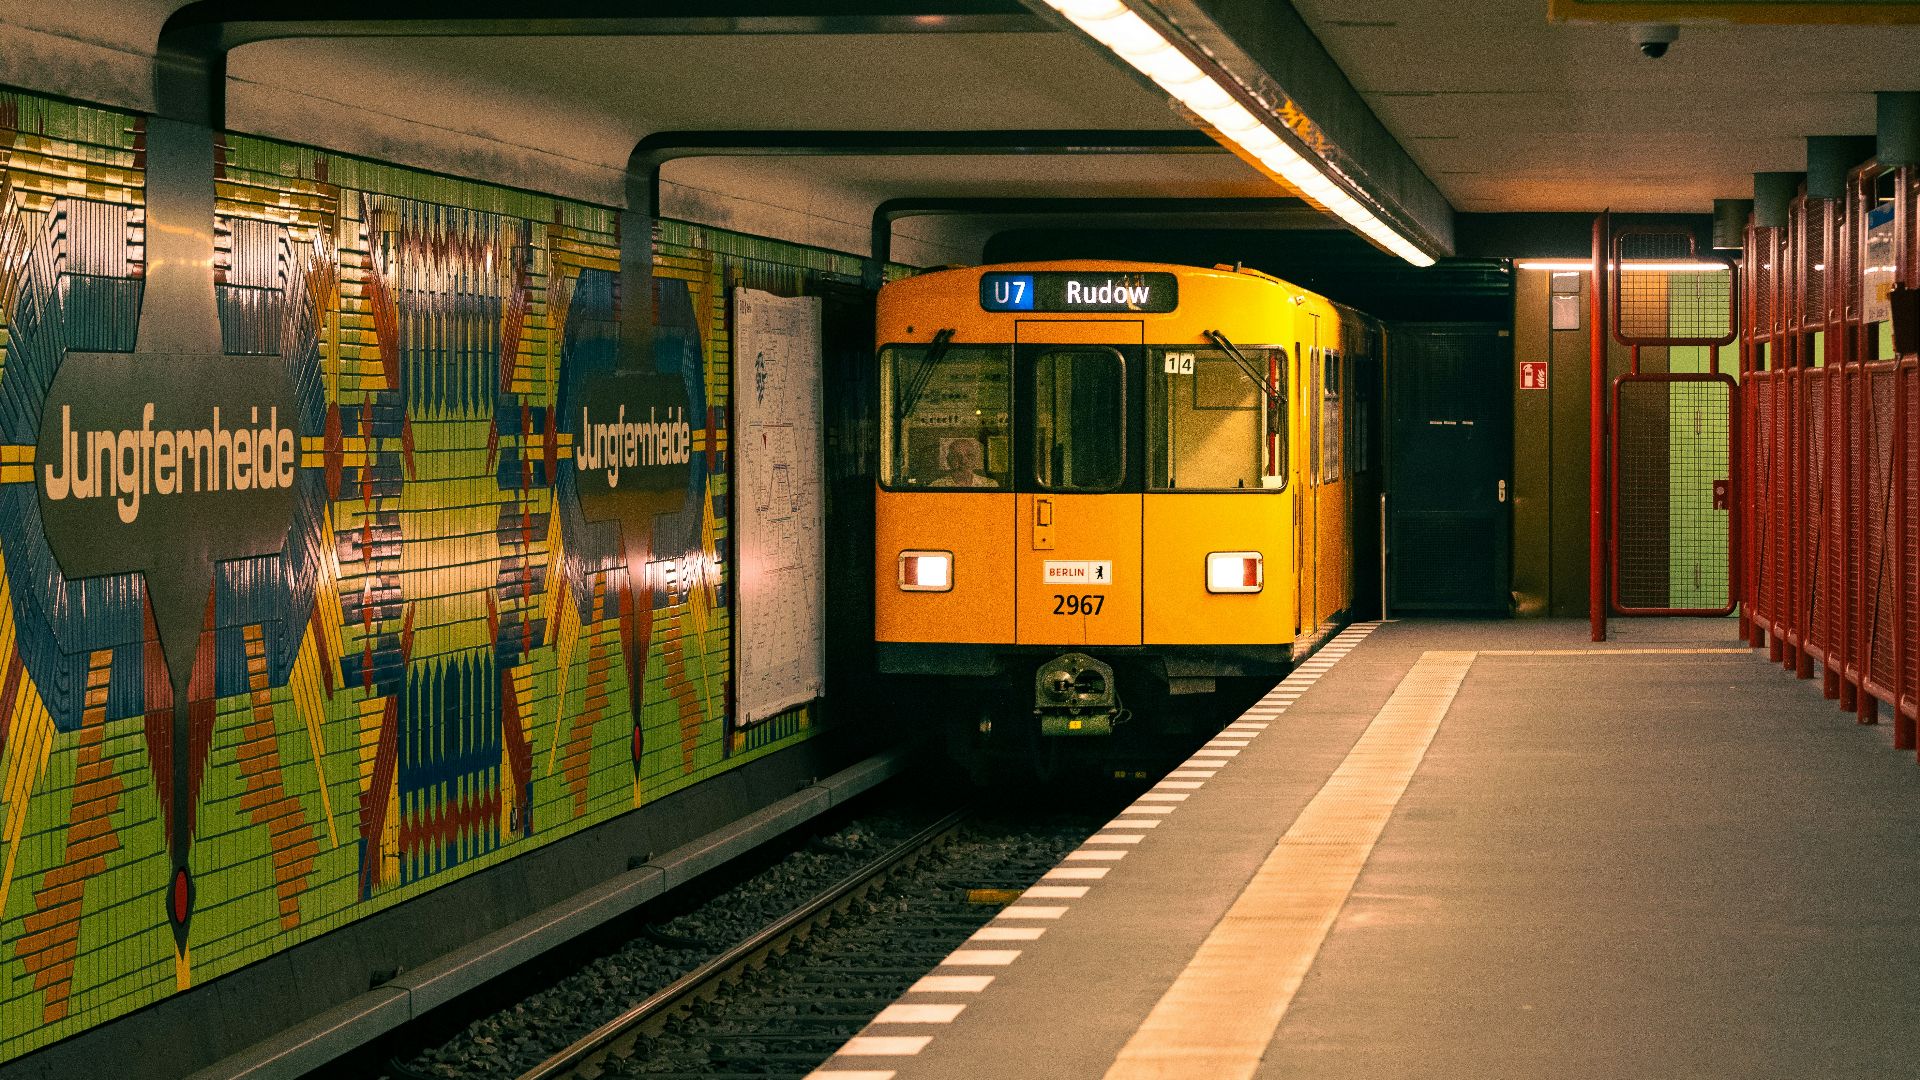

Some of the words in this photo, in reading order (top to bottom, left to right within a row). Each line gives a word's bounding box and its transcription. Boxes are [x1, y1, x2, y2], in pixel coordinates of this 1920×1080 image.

[995, 281, 1026, 304] U7
[1067, 280, 1150, 304] Rudow
[576, 404, 690, 488] Jungfernheide
[45, 402, 295, 524] Jungfernheide
[1049, 568, 1085, 577] BERLIN
[1053, 594, 1105, 616] 2967
